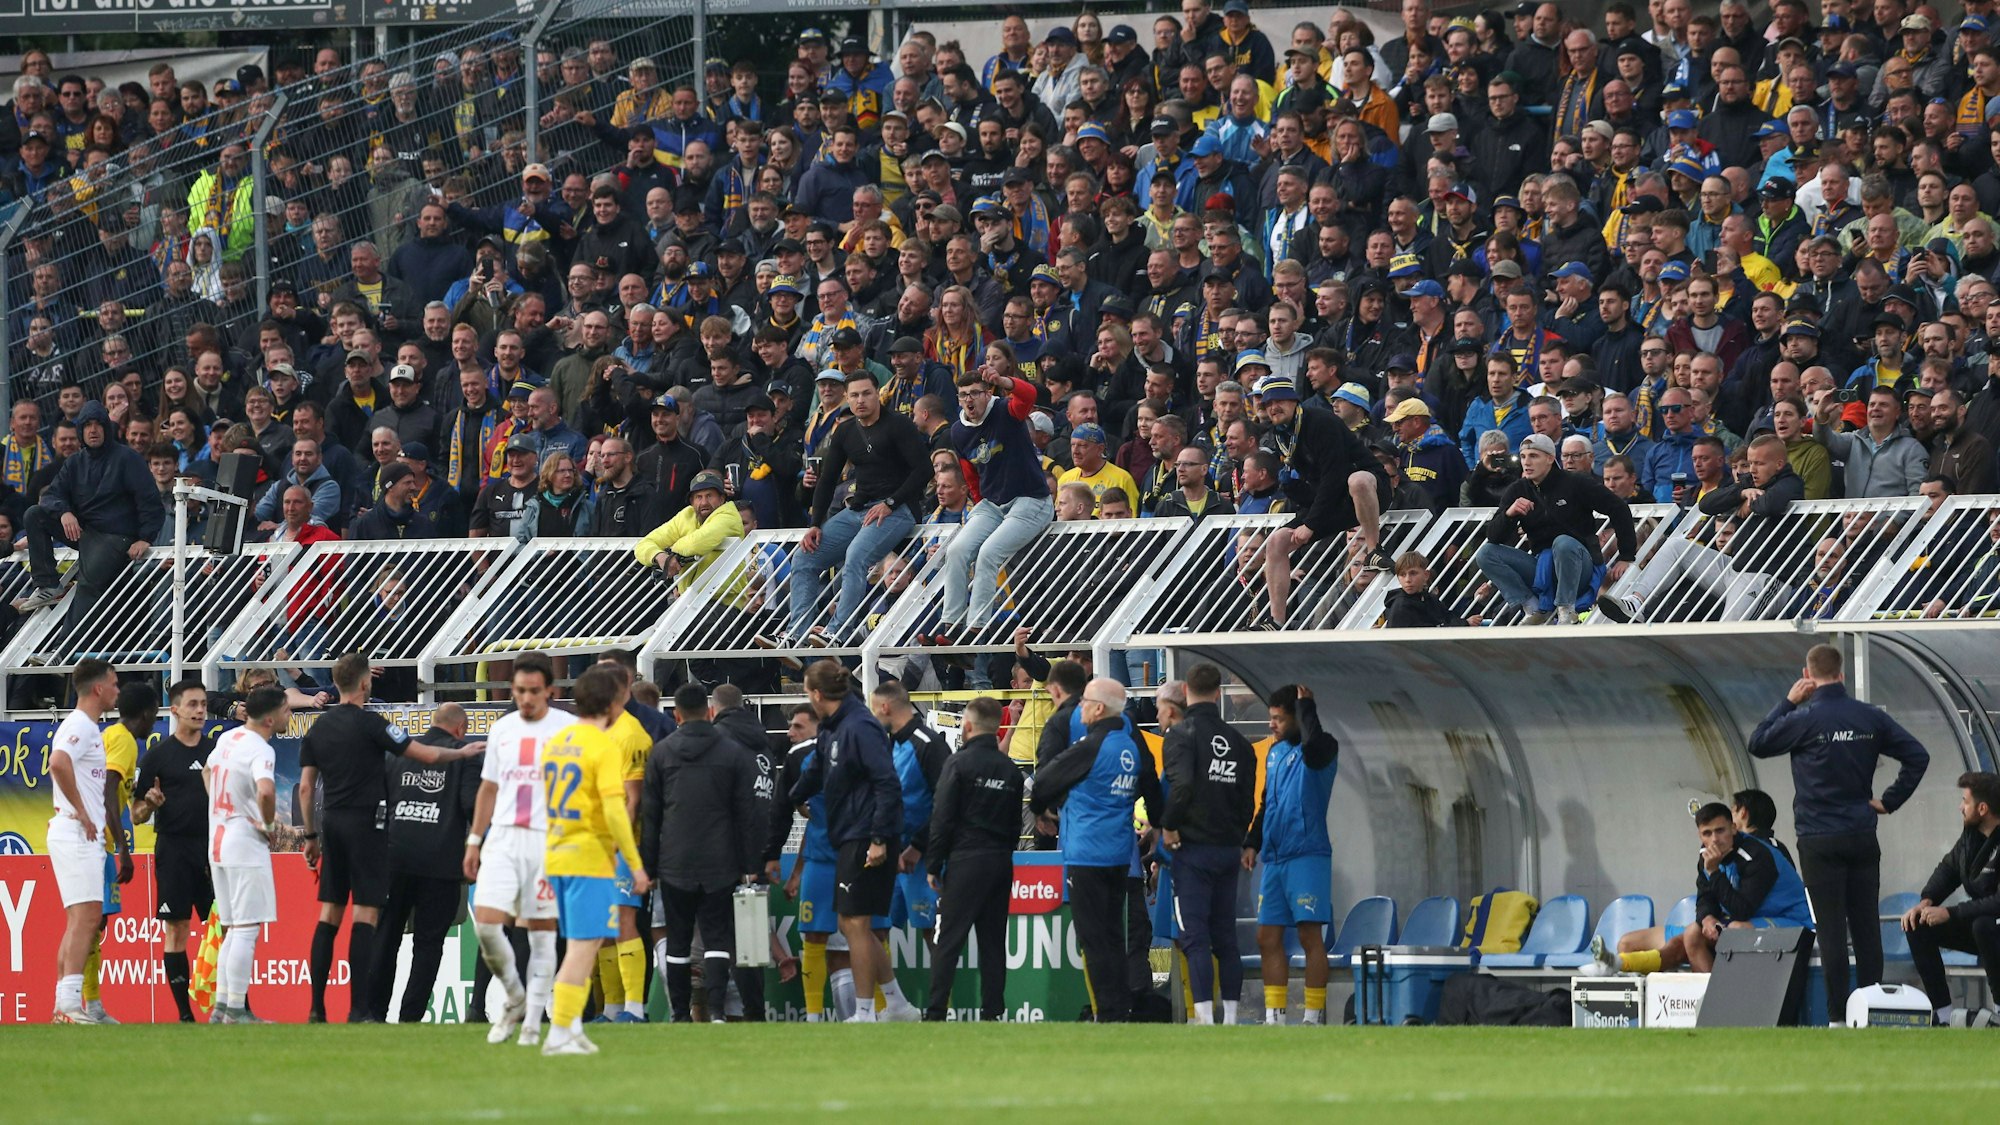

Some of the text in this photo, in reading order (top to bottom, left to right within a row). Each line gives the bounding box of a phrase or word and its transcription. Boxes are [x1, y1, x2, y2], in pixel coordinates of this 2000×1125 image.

[1832, 730, 1854, 742] AMZ
[984, 778, 1005, 789] AMZ
[544, 761, 582, 820] 22
